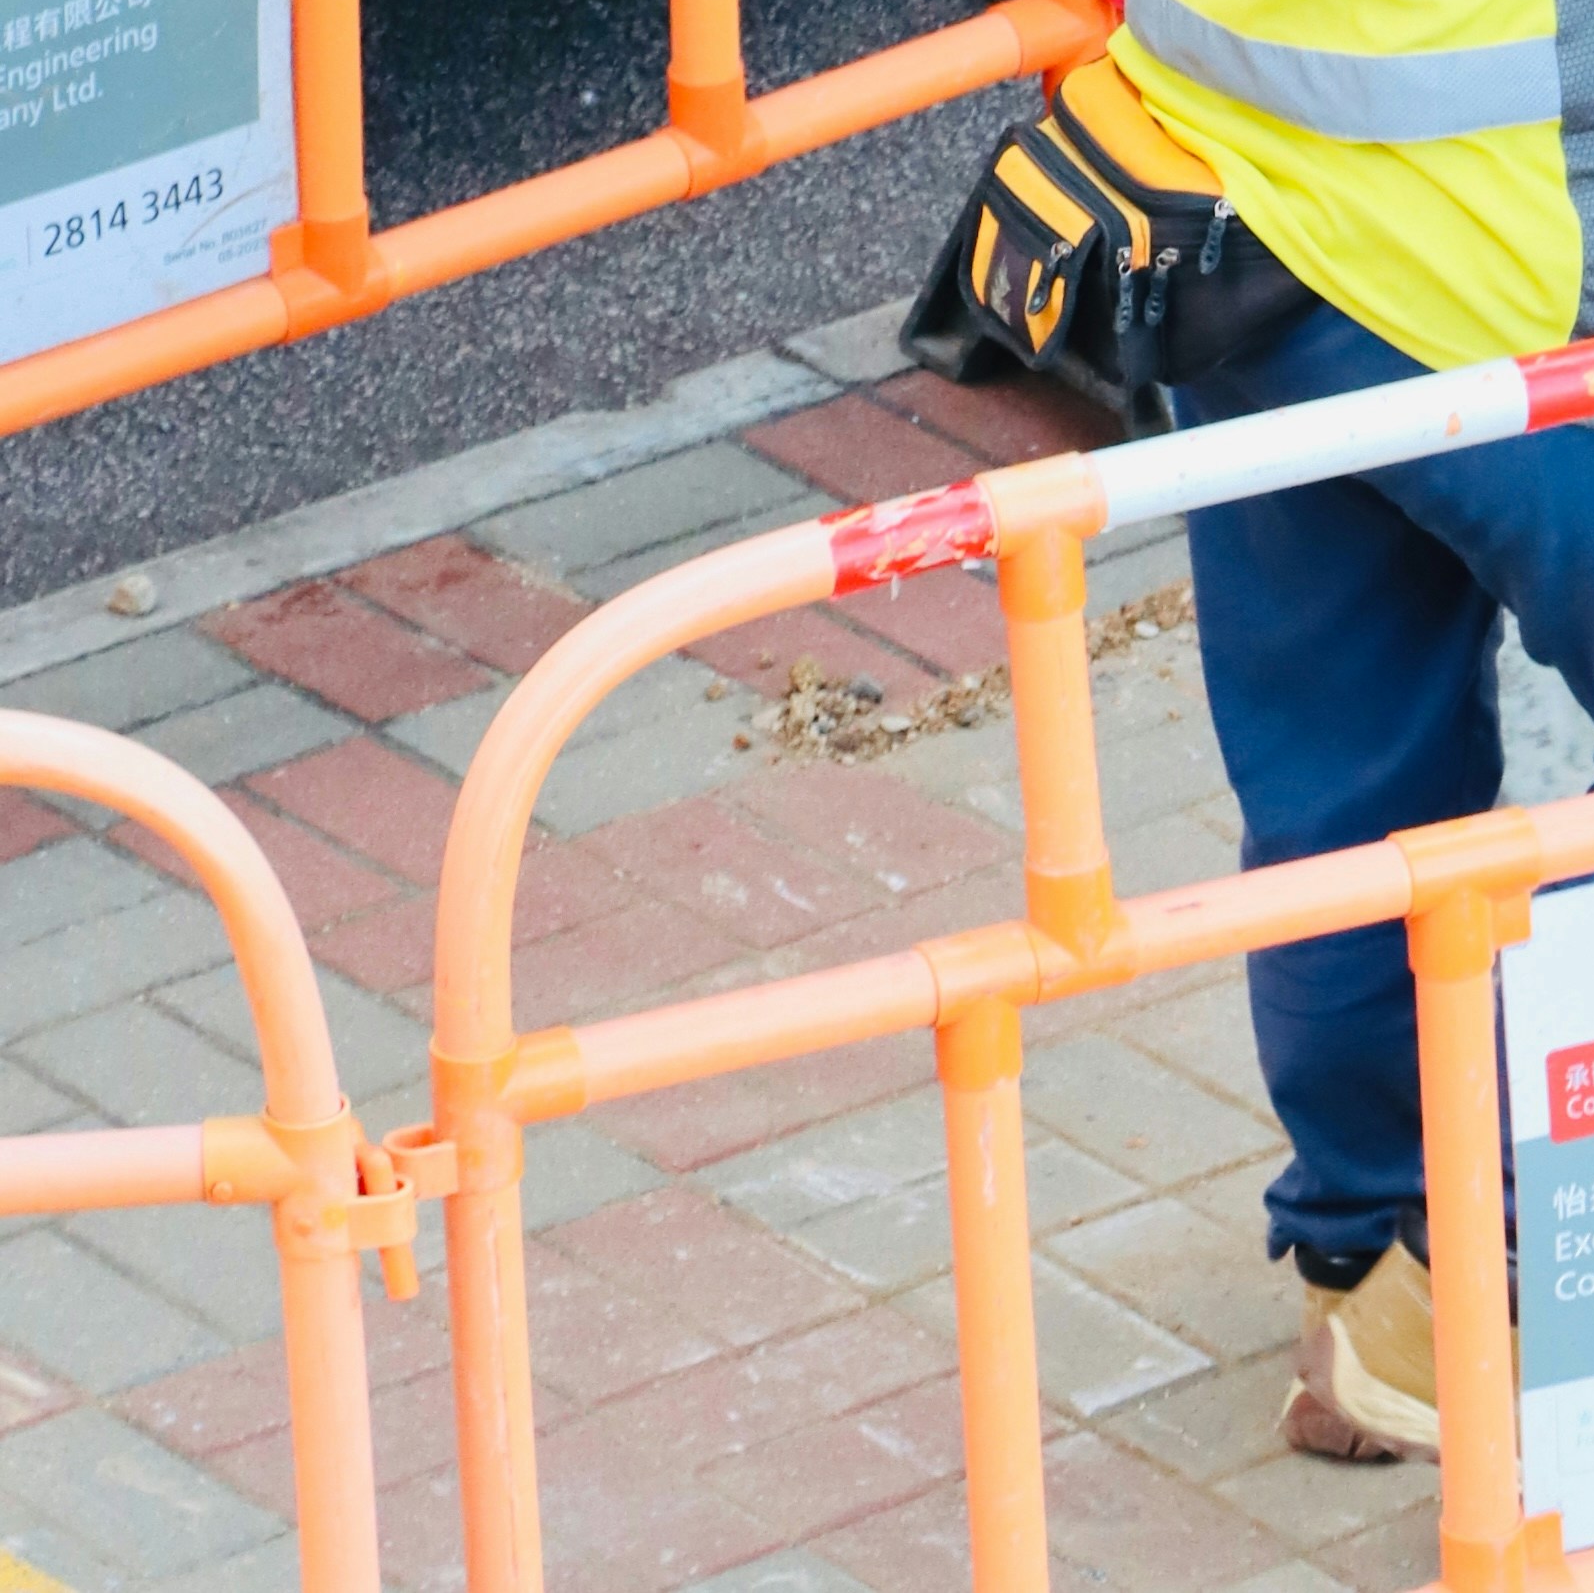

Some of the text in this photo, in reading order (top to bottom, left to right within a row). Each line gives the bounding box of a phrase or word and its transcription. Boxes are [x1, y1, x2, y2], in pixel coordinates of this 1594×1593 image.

[52, 71, 104, 112] Ltd.
[43, 167, 224, 257] 2814 3443
